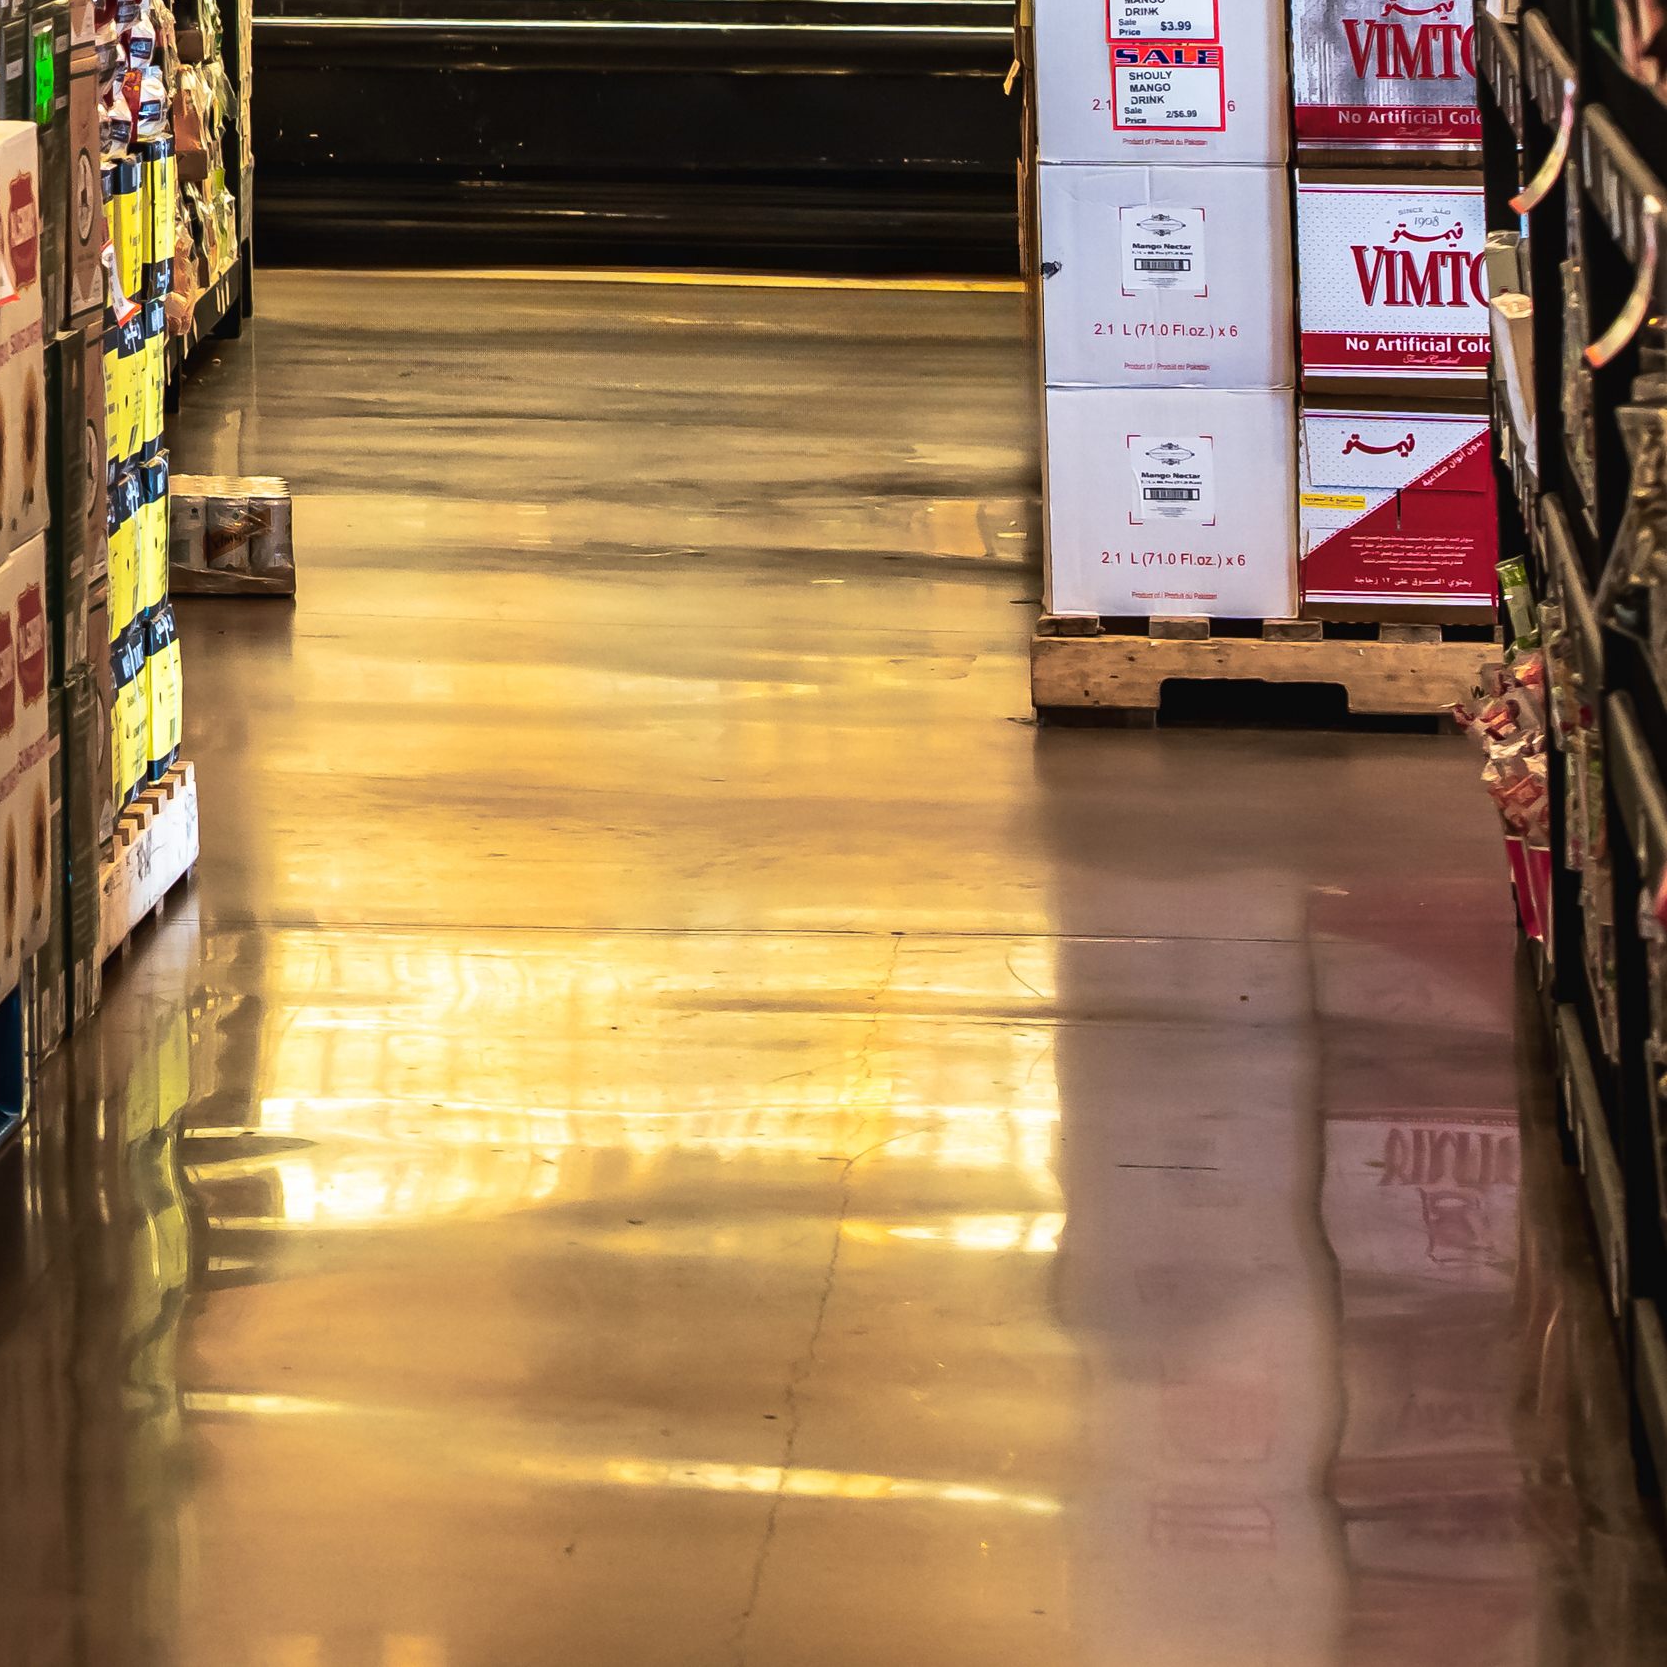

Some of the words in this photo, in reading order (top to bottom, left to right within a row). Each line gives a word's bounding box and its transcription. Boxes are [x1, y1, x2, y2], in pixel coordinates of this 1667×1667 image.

[1125, 7, 1159, 16] DRINK
[1118, 18, 1136, 26] Sale
[1160, 20, 1192, 32] $3.99
[1119, 28, 1141, 36] Price
[1115, 49, 1220, 65] SALE
[1128, 71, 1172, 81] SHOULY
[1129, 83, 1171, 93] MANGO
[1131, 95, 1165, 105] DRINK
[1124, 107, 1142, 115] Sale
[1227, 100, 1236, 112] 6
[1166, 110, 1198, 119] 2/$6.99
[1338, 111, 1362, 124] No
[1368, 110, 1443, 124] Artificial
[1125, 117, 1147, 125] Price
[1094, 323, 1114, 335] 2.1
[1123, 324, 1131, 335] L
[1229, 325, 1238, 337] 6
[1346, 338, 1369, 351] No
[1376, 337, 1451, 352] Artificial
[1101, 552, 1121, 564] 2.1
[1131, 552, 1138, 564] L
[1237, 555, 1246, 566] 6
